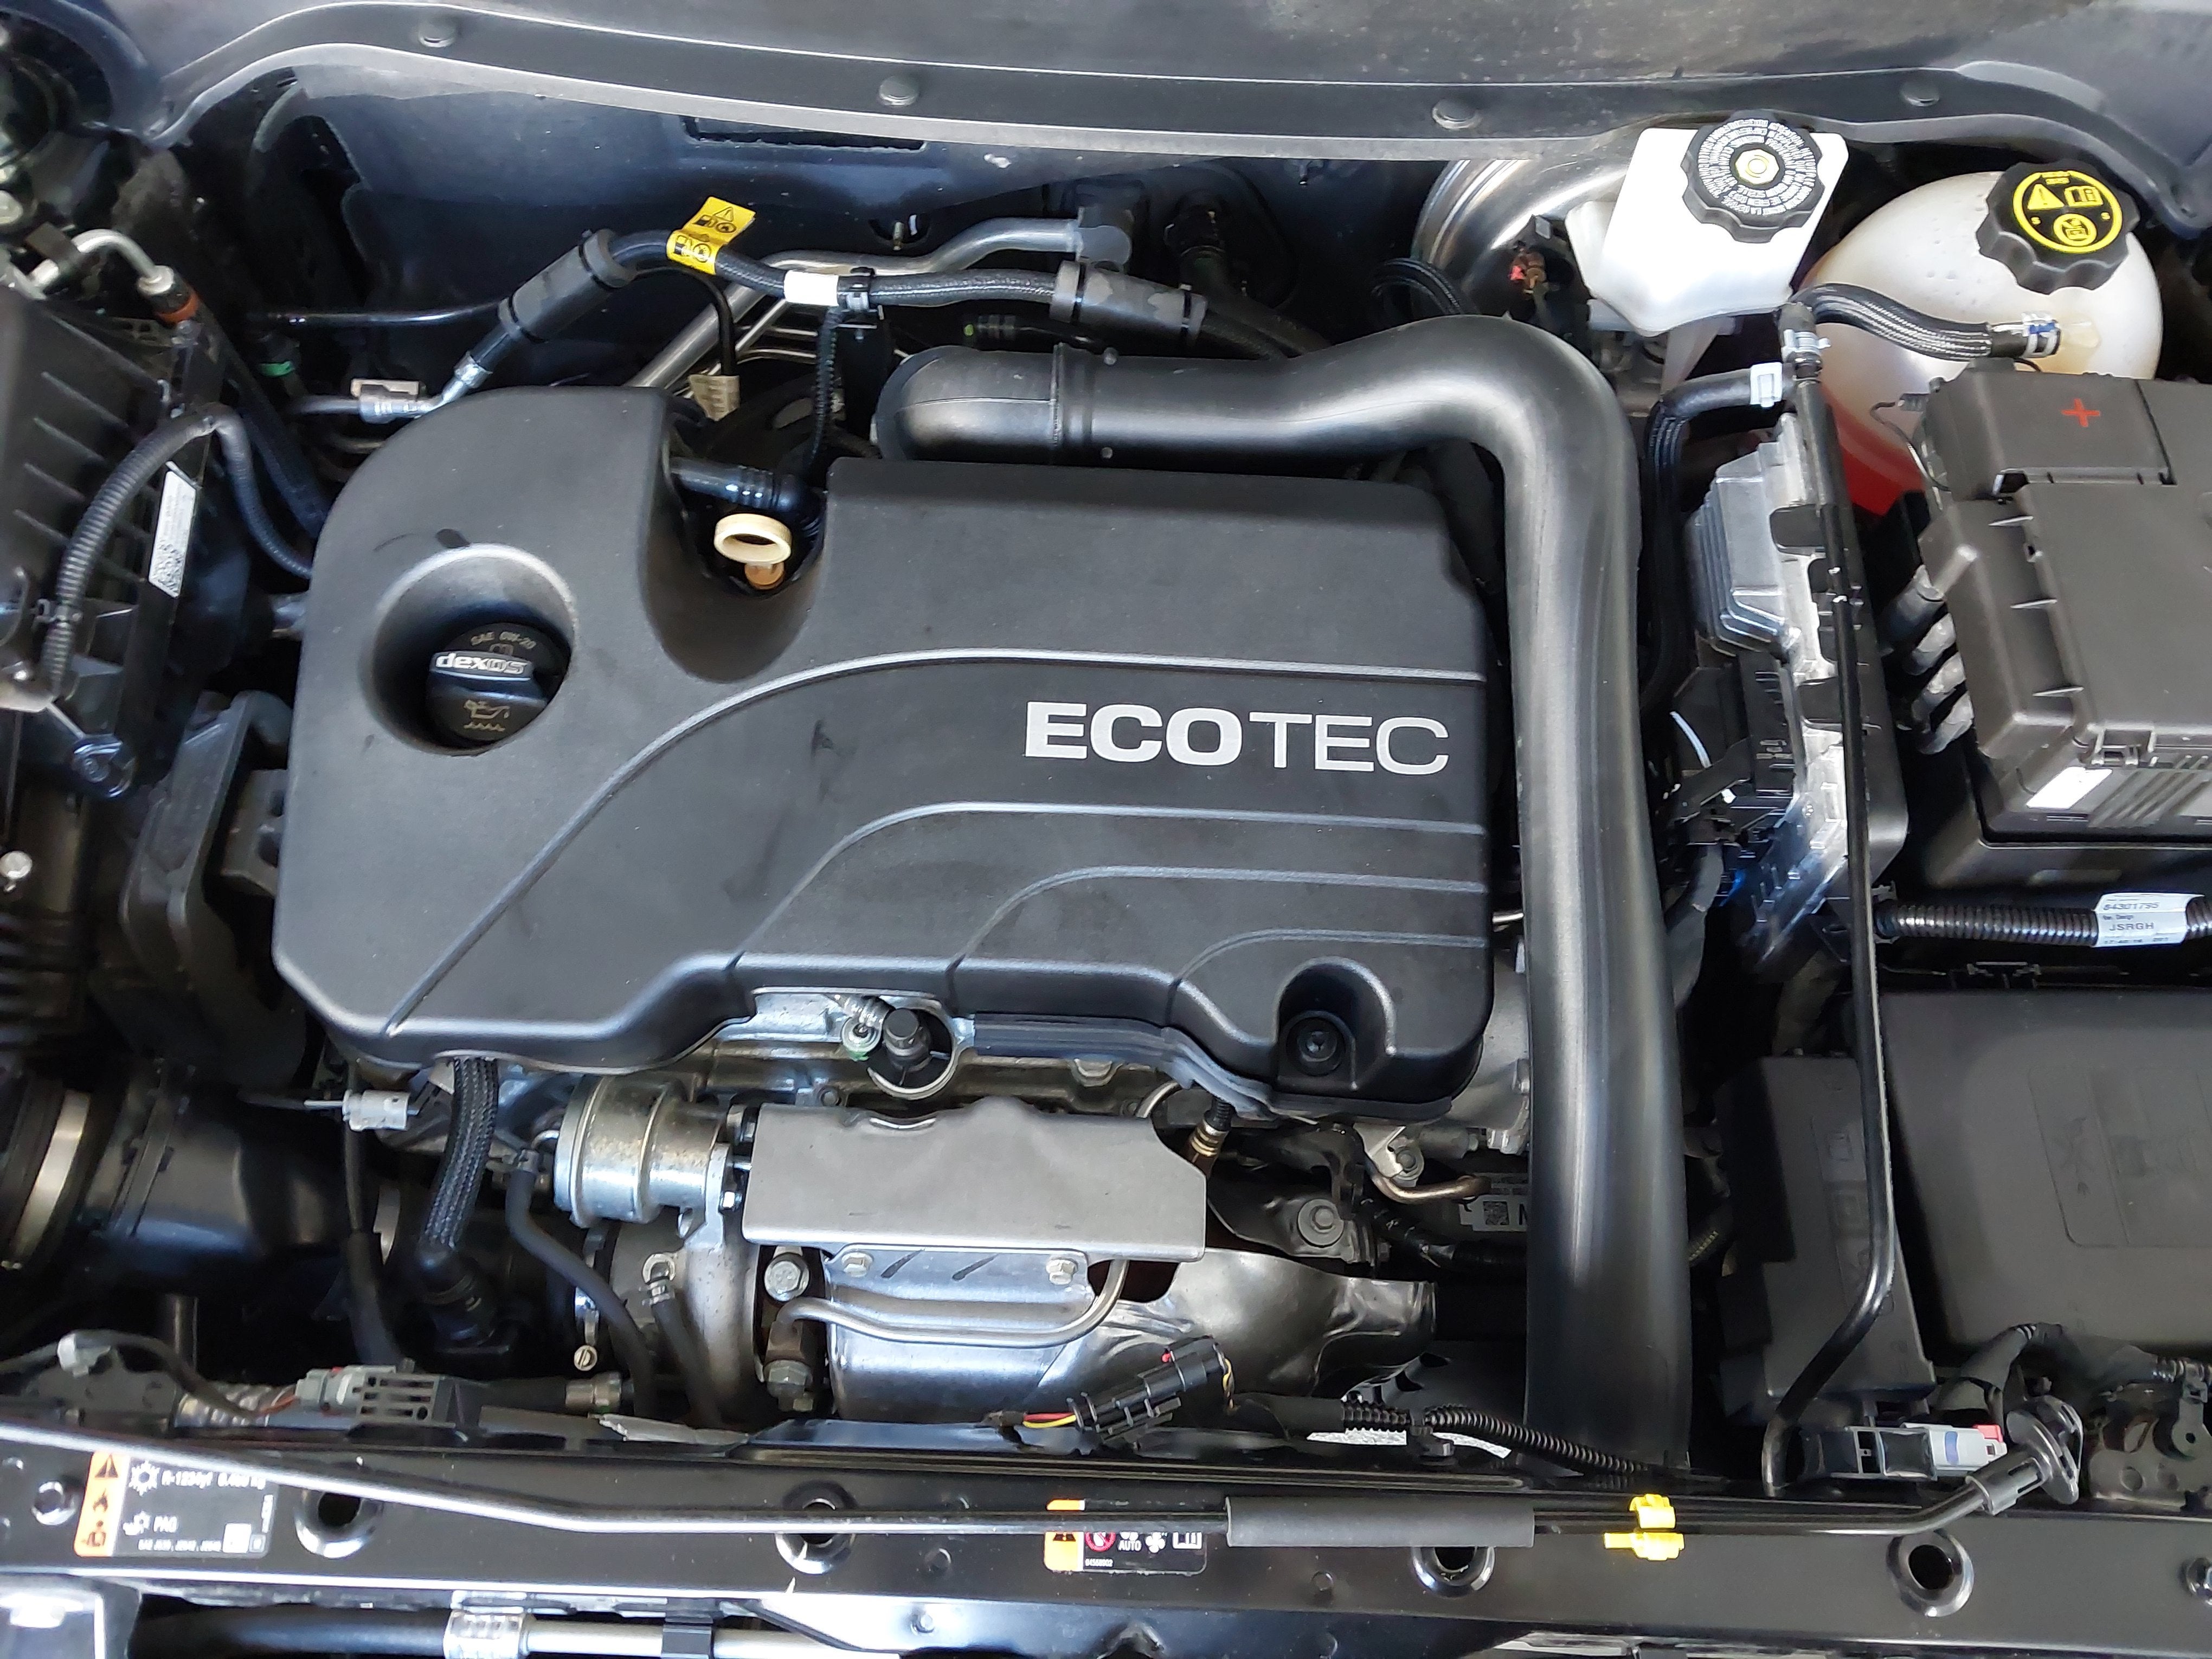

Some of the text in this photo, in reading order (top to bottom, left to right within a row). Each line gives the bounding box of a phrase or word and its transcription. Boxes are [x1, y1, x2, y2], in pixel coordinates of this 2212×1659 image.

[435, 653, 529, 674] dexos
[1025, 701, 1450, 775] ECOTEC
[1118, 1540, 1142, 1551] AUTO
